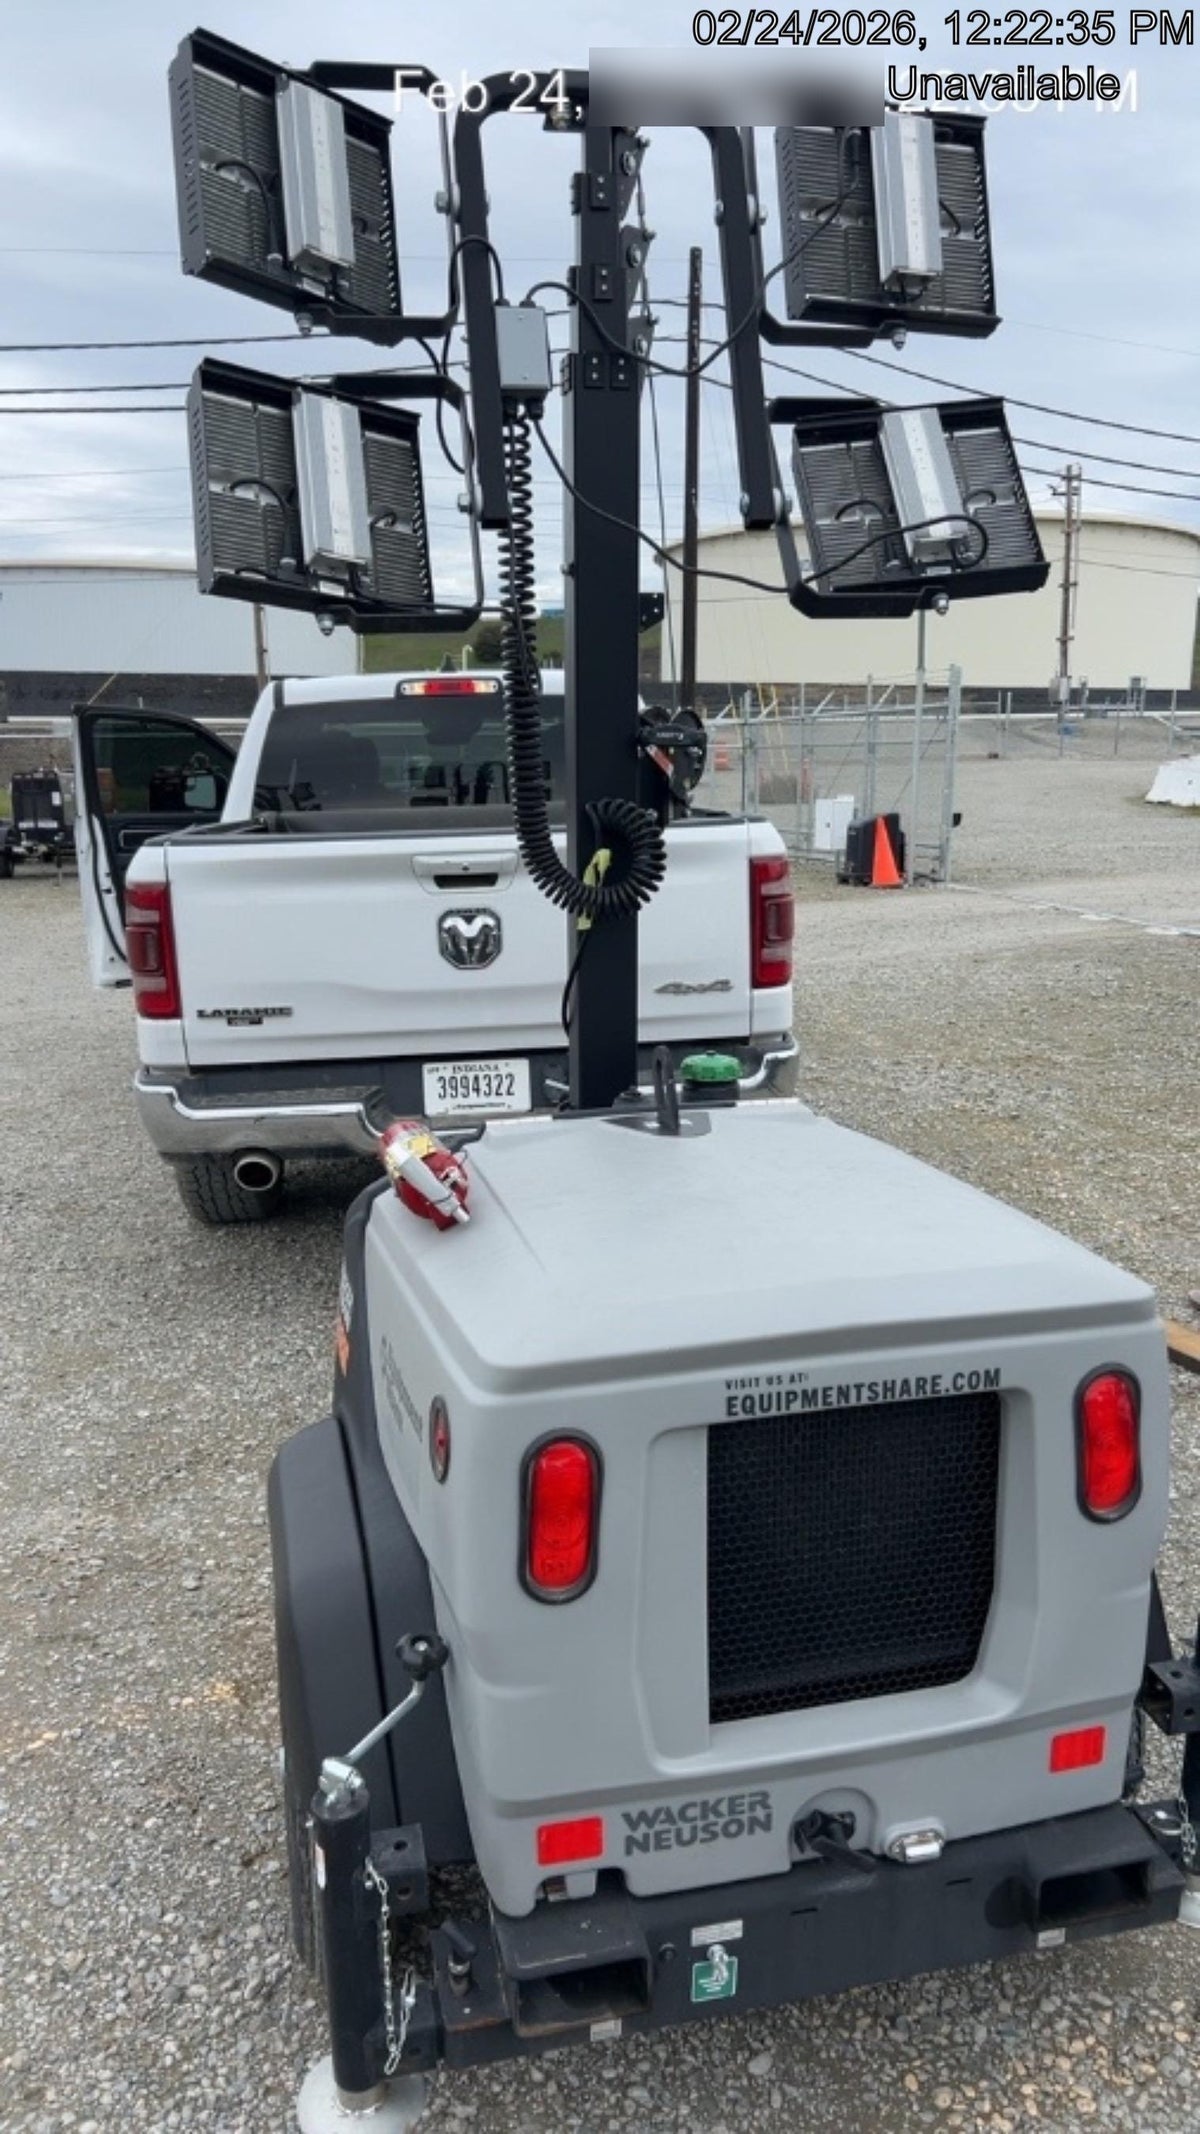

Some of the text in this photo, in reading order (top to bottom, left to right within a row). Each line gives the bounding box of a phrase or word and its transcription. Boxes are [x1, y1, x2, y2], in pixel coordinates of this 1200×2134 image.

[437, 1071, 515, 1099] 3994322
[725, 1377, 760, 1390] VISIT
[766, 1374, 783, 1386] US
[726, 1367, 1001, 1417] EQUIPMENTSHARE.COM
[621, 1790, 773, 1832] WACKER
[625, 1812, 772, 1856] NEUSON
